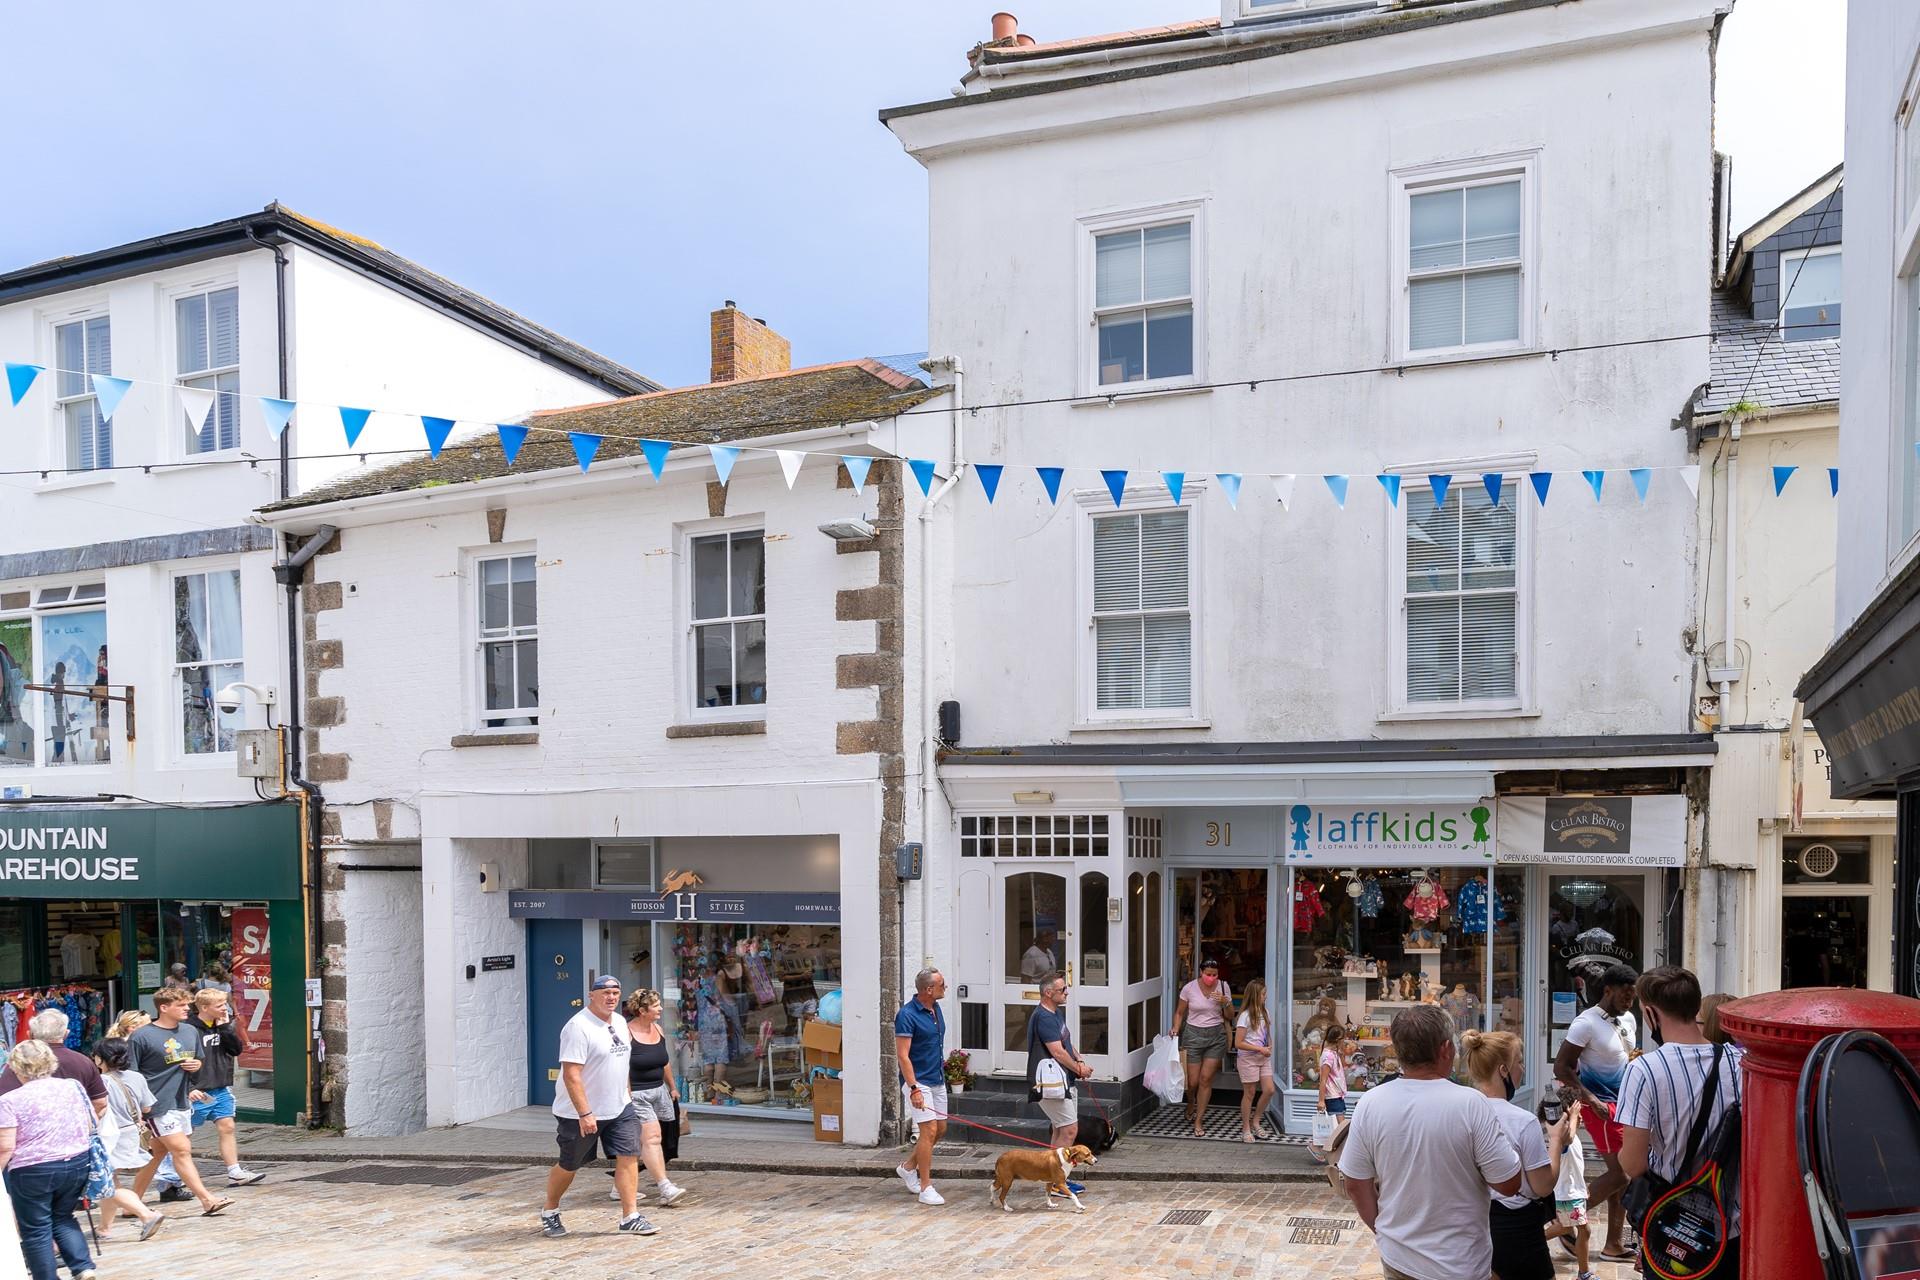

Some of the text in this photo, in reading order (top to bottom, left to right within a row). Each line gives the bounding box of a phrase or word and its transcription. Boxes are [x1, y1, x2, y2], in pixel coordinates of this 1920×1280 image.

[1317, 811, 1457, 842] laffkids
[1206, 822, 1231, 847] 31
[1503, 853, 1676, 865] OPEN AS USUAL WHILST OUTSIDE WORK IS COMPLETED
[0, 857, 139, 881] REHOUSE
[513, 901, 528, 909] EST.
[631, 902, 665, 911] HUDSON
[674, 893, 698, 921] H
[709, 903, 745, 911] ST IVES
[794, 904, 837, 912] HOMEWARE,
[243, 975, 269, 985] UP TO
